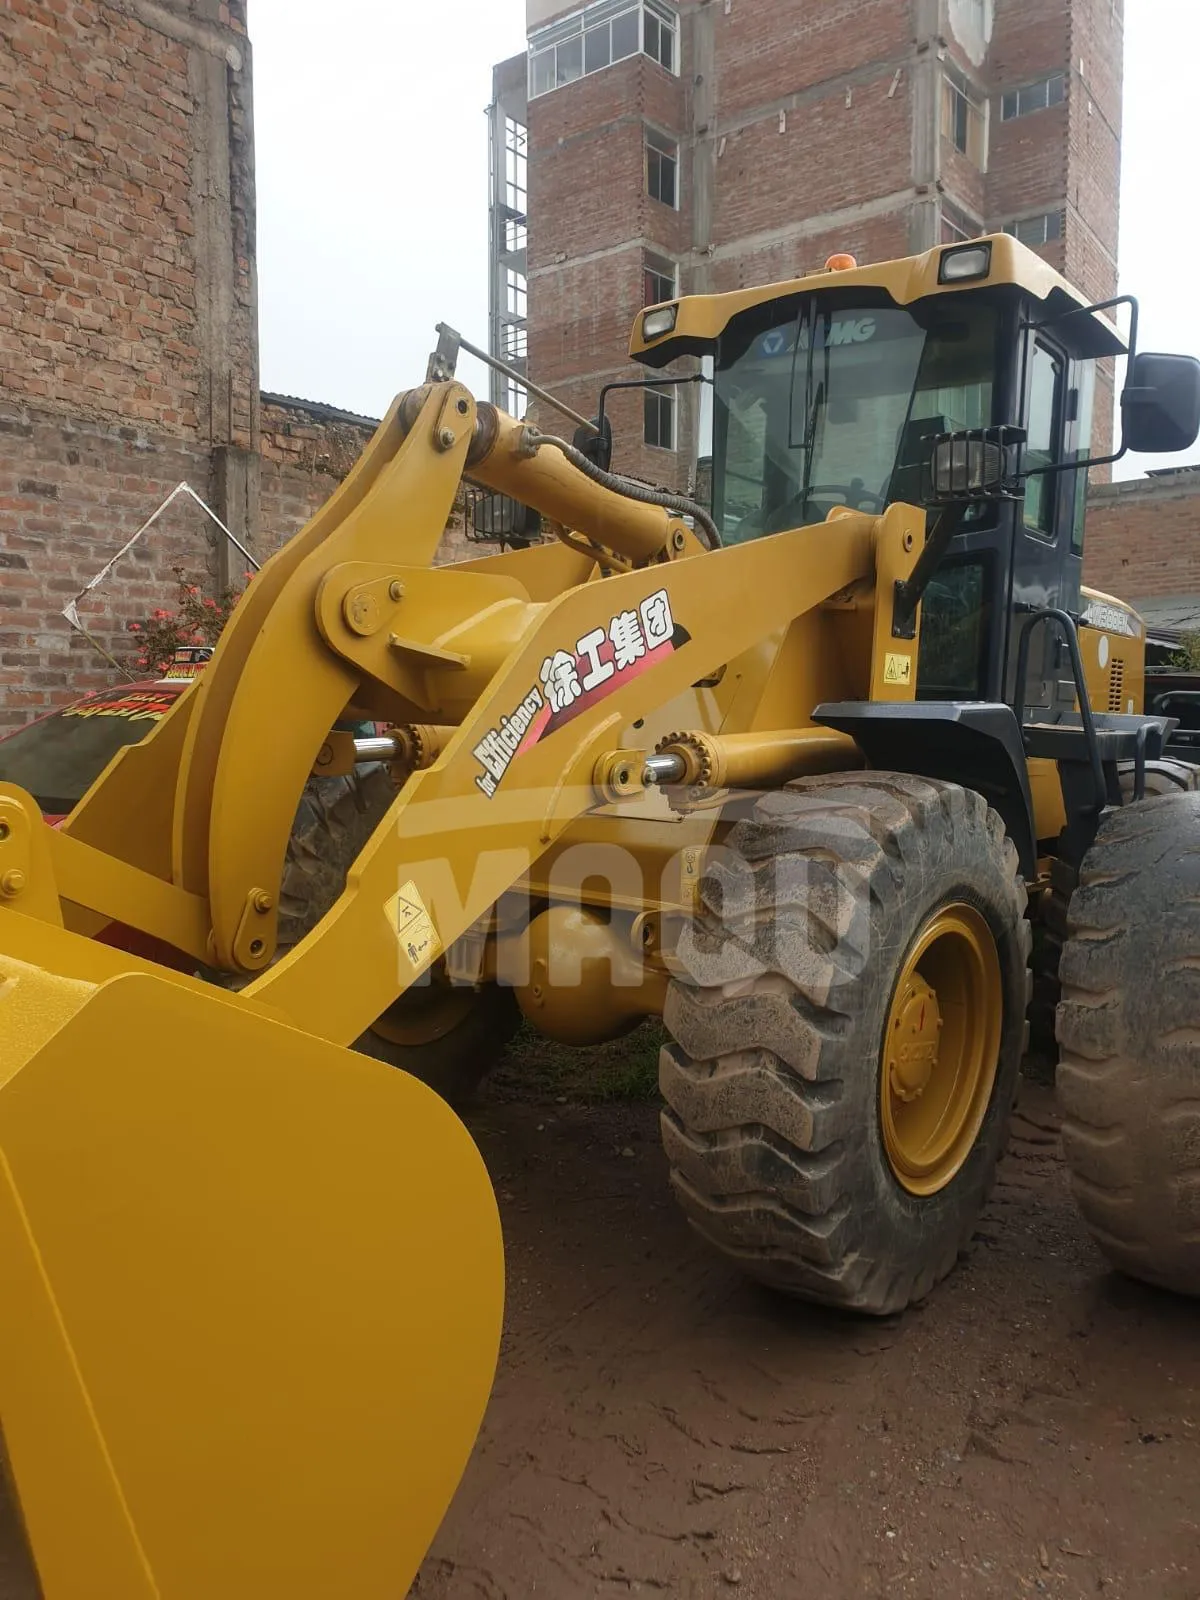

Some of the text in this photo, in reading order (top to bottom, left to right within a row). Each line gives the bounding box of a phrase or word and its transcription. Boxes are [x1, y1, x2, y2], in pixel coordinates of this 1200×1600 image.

[539, 588, 674, 713] 徐工集团
[472, 684, 543, 799] for Efficiency
